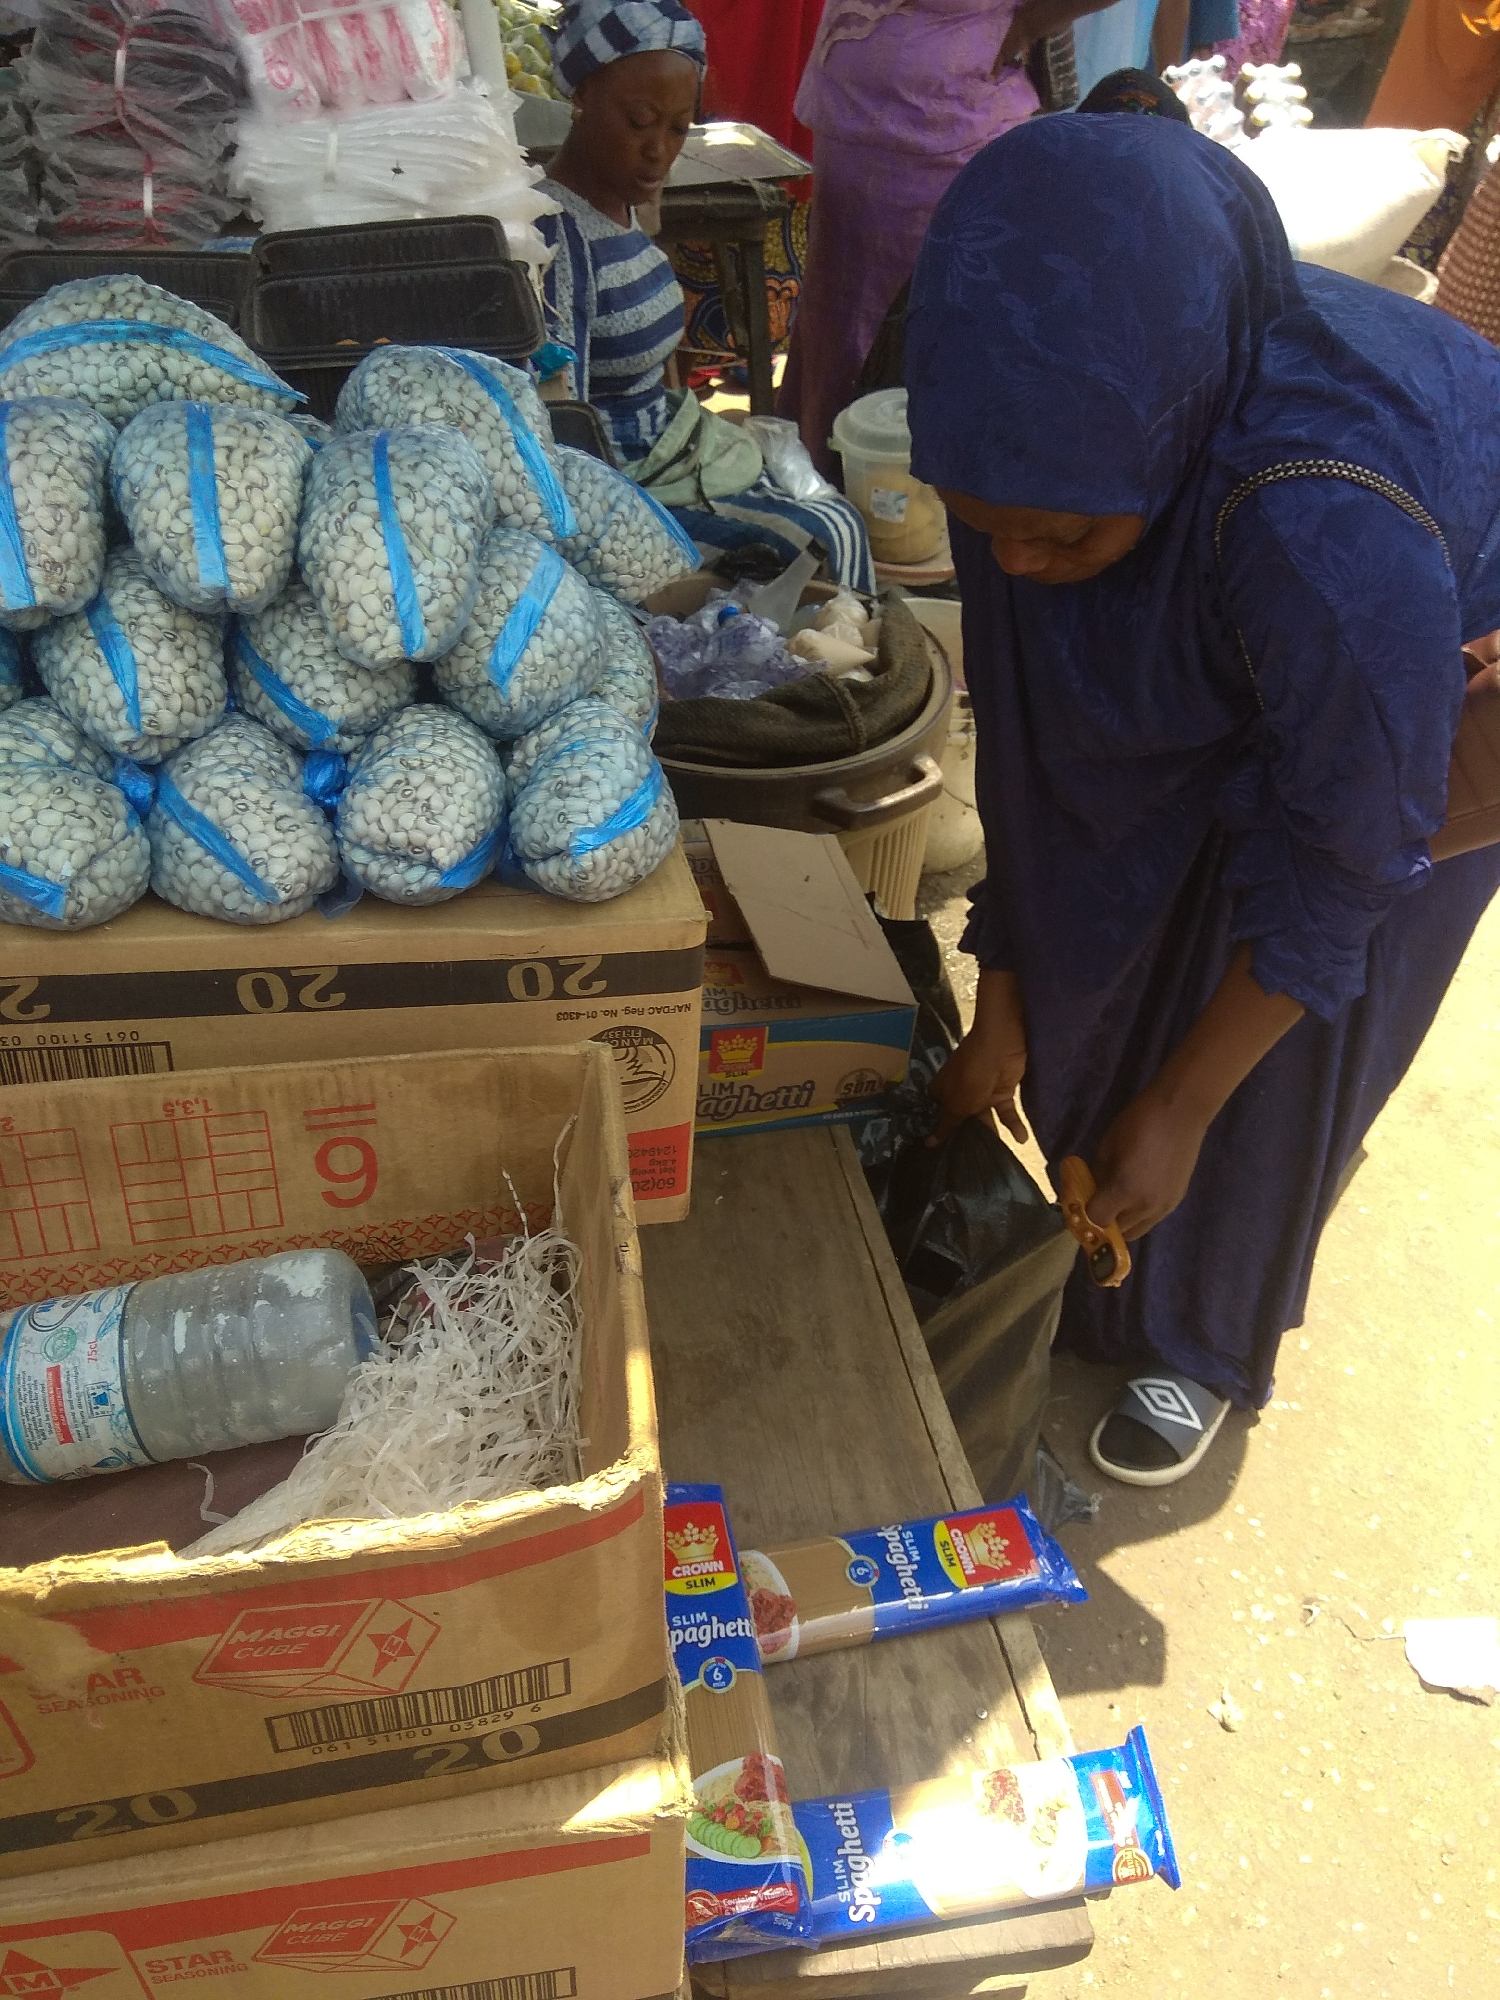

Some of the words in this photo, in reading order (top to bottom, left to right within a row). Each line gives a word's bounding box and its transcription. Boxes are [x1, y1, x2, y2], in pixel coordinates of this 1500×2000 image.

[507, 956, 608, 1000] 20
[0, 976, 50, 1020] 2
[236, 966, 346, 1014] 20
[600, 1009, 618, 1018] No.
[622, 1006, 645, 1016] Reg.
[650, 1003, 691, 1014] NAFDAC
[701, 992, 806, 1015] aghetti
[556, 1011, 597, 1021] 01-4303
[0, 1036, 21, 1046] 03
[37, 1033, 93, 1045] 51100
[106, 1030, 140, 1042] 061
[700, 1082, 734, 1097] LIM
[697, 1080, 816, 1121] aghetti
[902, 1530, 921, 1562] SLIM
[939, 1540, 957, 1568] SLIM
[950, 1528, 976, 1575] CROWN
[671, 1561, 724, 1578] CROWN
[876, 1524, 930, 1611] Spaghetti
[685, 1576, 716, 1589] SLIM
[672, 1612, 708, 1627] SLIM
[228, 1624, 342, 1645] MAGGI
[670, 1616, 755, 1652] paghett
[233, 1643, 309, 1660] CUBE
[712, 1667, 723, 1680] 6
[36, 1686, 166, 1714] SEASONING
[312, 1741, 351, 1756] 061
[368, 1727, 433, 1746] 51100
[450, 1710, 514, 1733] 03829
[530, 1703, 542, 1713] 6
[413, 1724, 542, 1777] 20
[56, 1789, 198, 1841] 20
[828, 1802, 882, 1923] Spaghetti
[832, 1859, 851, 1902] SLIM
[283, 1917, 375, 1934] MAGGI
[286, 1932, 349, 1945] CUBE
[145, 1949, 235, 1975] STAR
[11, 1972, 55, 1992] M
[151, 1963, 249, 1984] SEASONING
